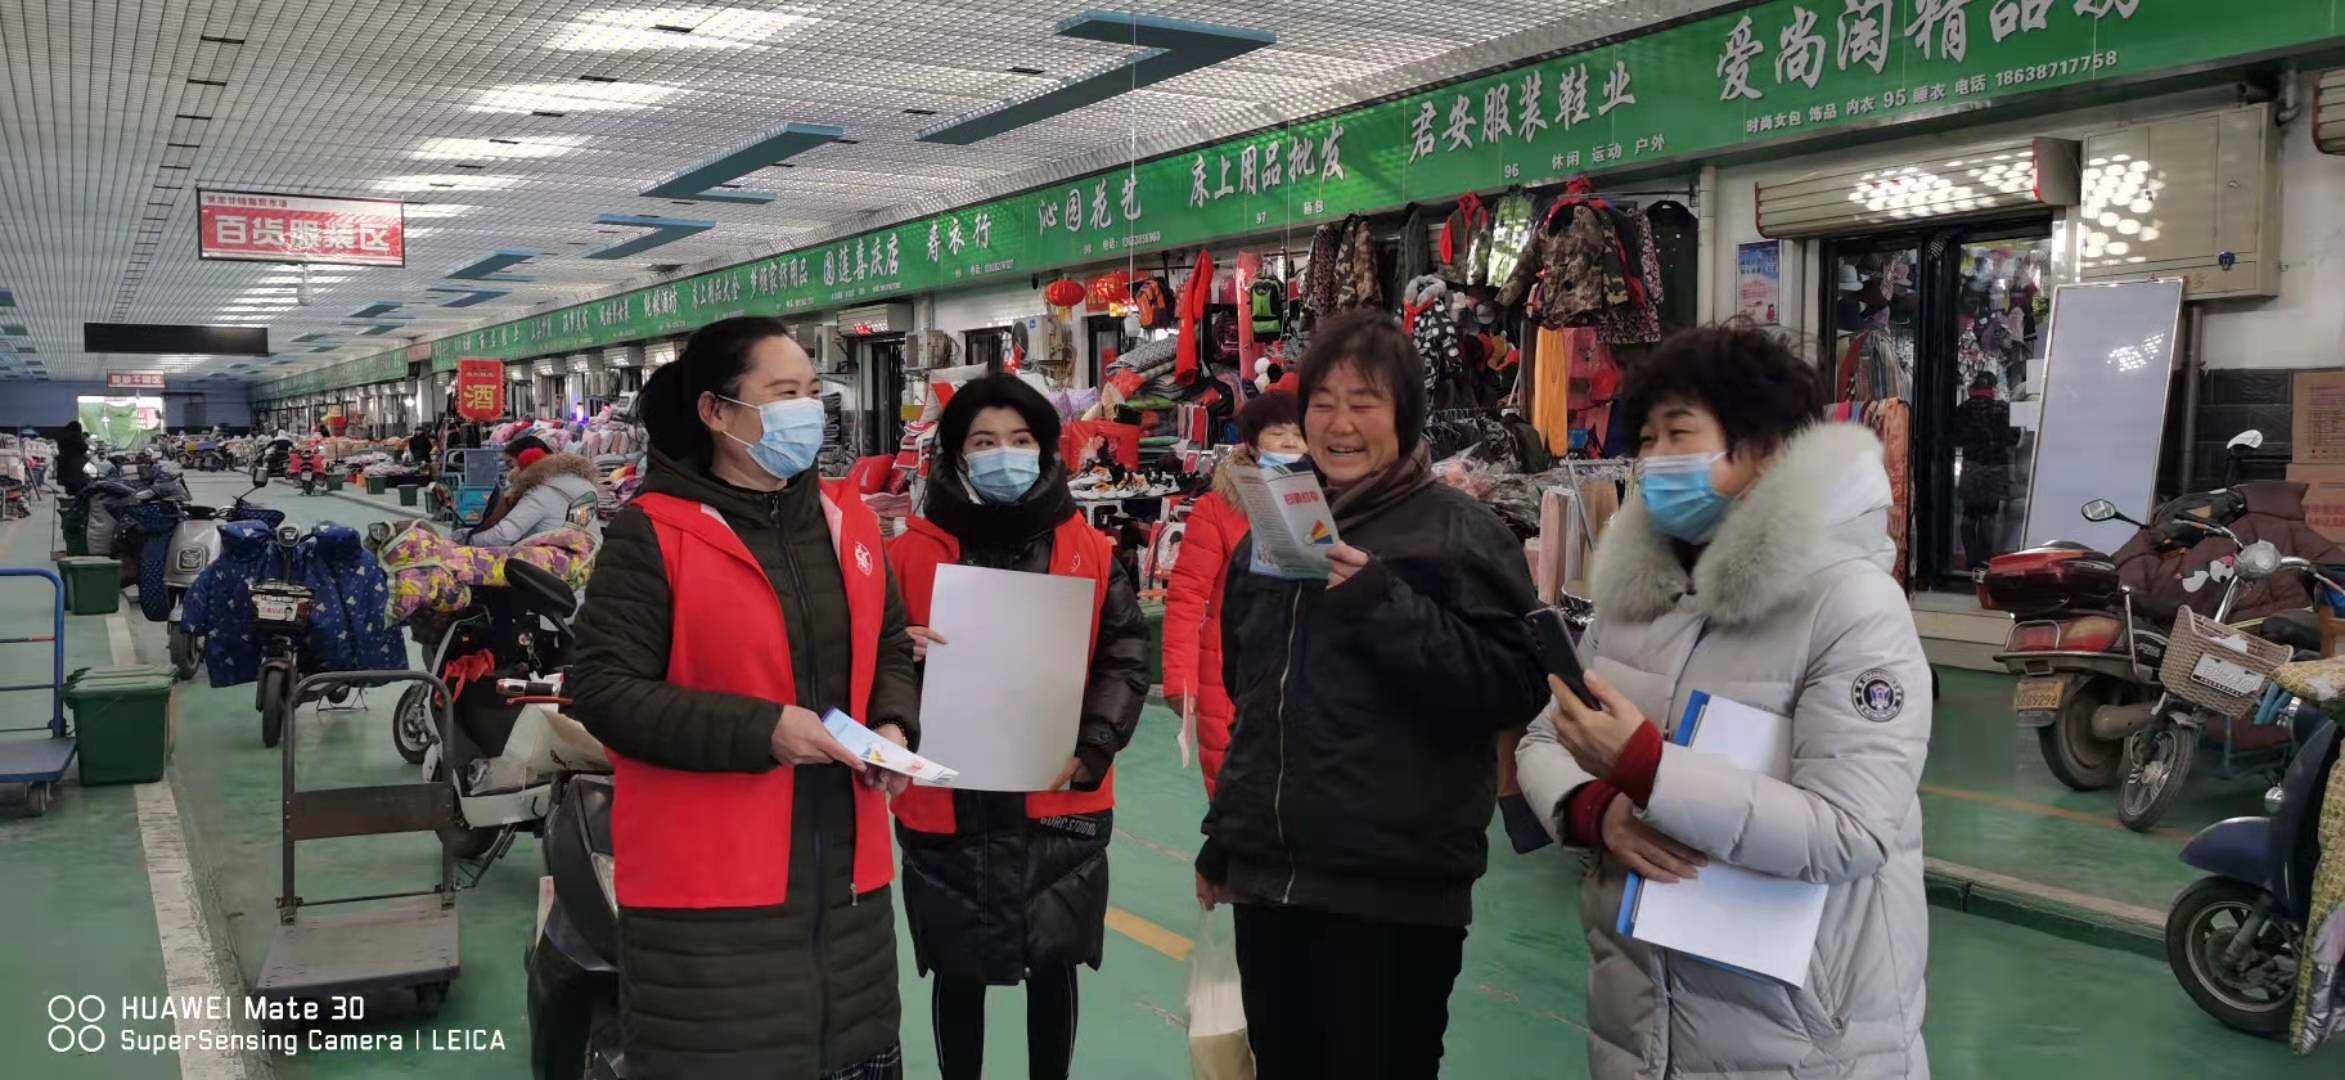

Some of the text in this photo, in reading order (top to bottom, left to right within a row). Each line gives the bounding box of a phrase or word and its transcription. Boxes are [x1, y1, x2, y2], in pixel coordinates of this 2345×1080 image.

[1408, 60, 1636, 165] 君安服装鞋业
[1746, 112, 1802, 133] 时尚女包
[1809, 104, 1838, 121] 饰品
[1846, 97, 1875, 115] 内衣
[1883, 88, 1907, 108] 95
[1955, 74, 1986, 95] 电话
[1995, 50, 2118, 87] 18638717758
[1189, 119, 1344, 208] 床上用品批发
[1504, 133, 1665, 178] 96 休闲 运动 户外
[215, 215, 391, 253] 百货服装区
[464, 384, 497, 410] 酒
